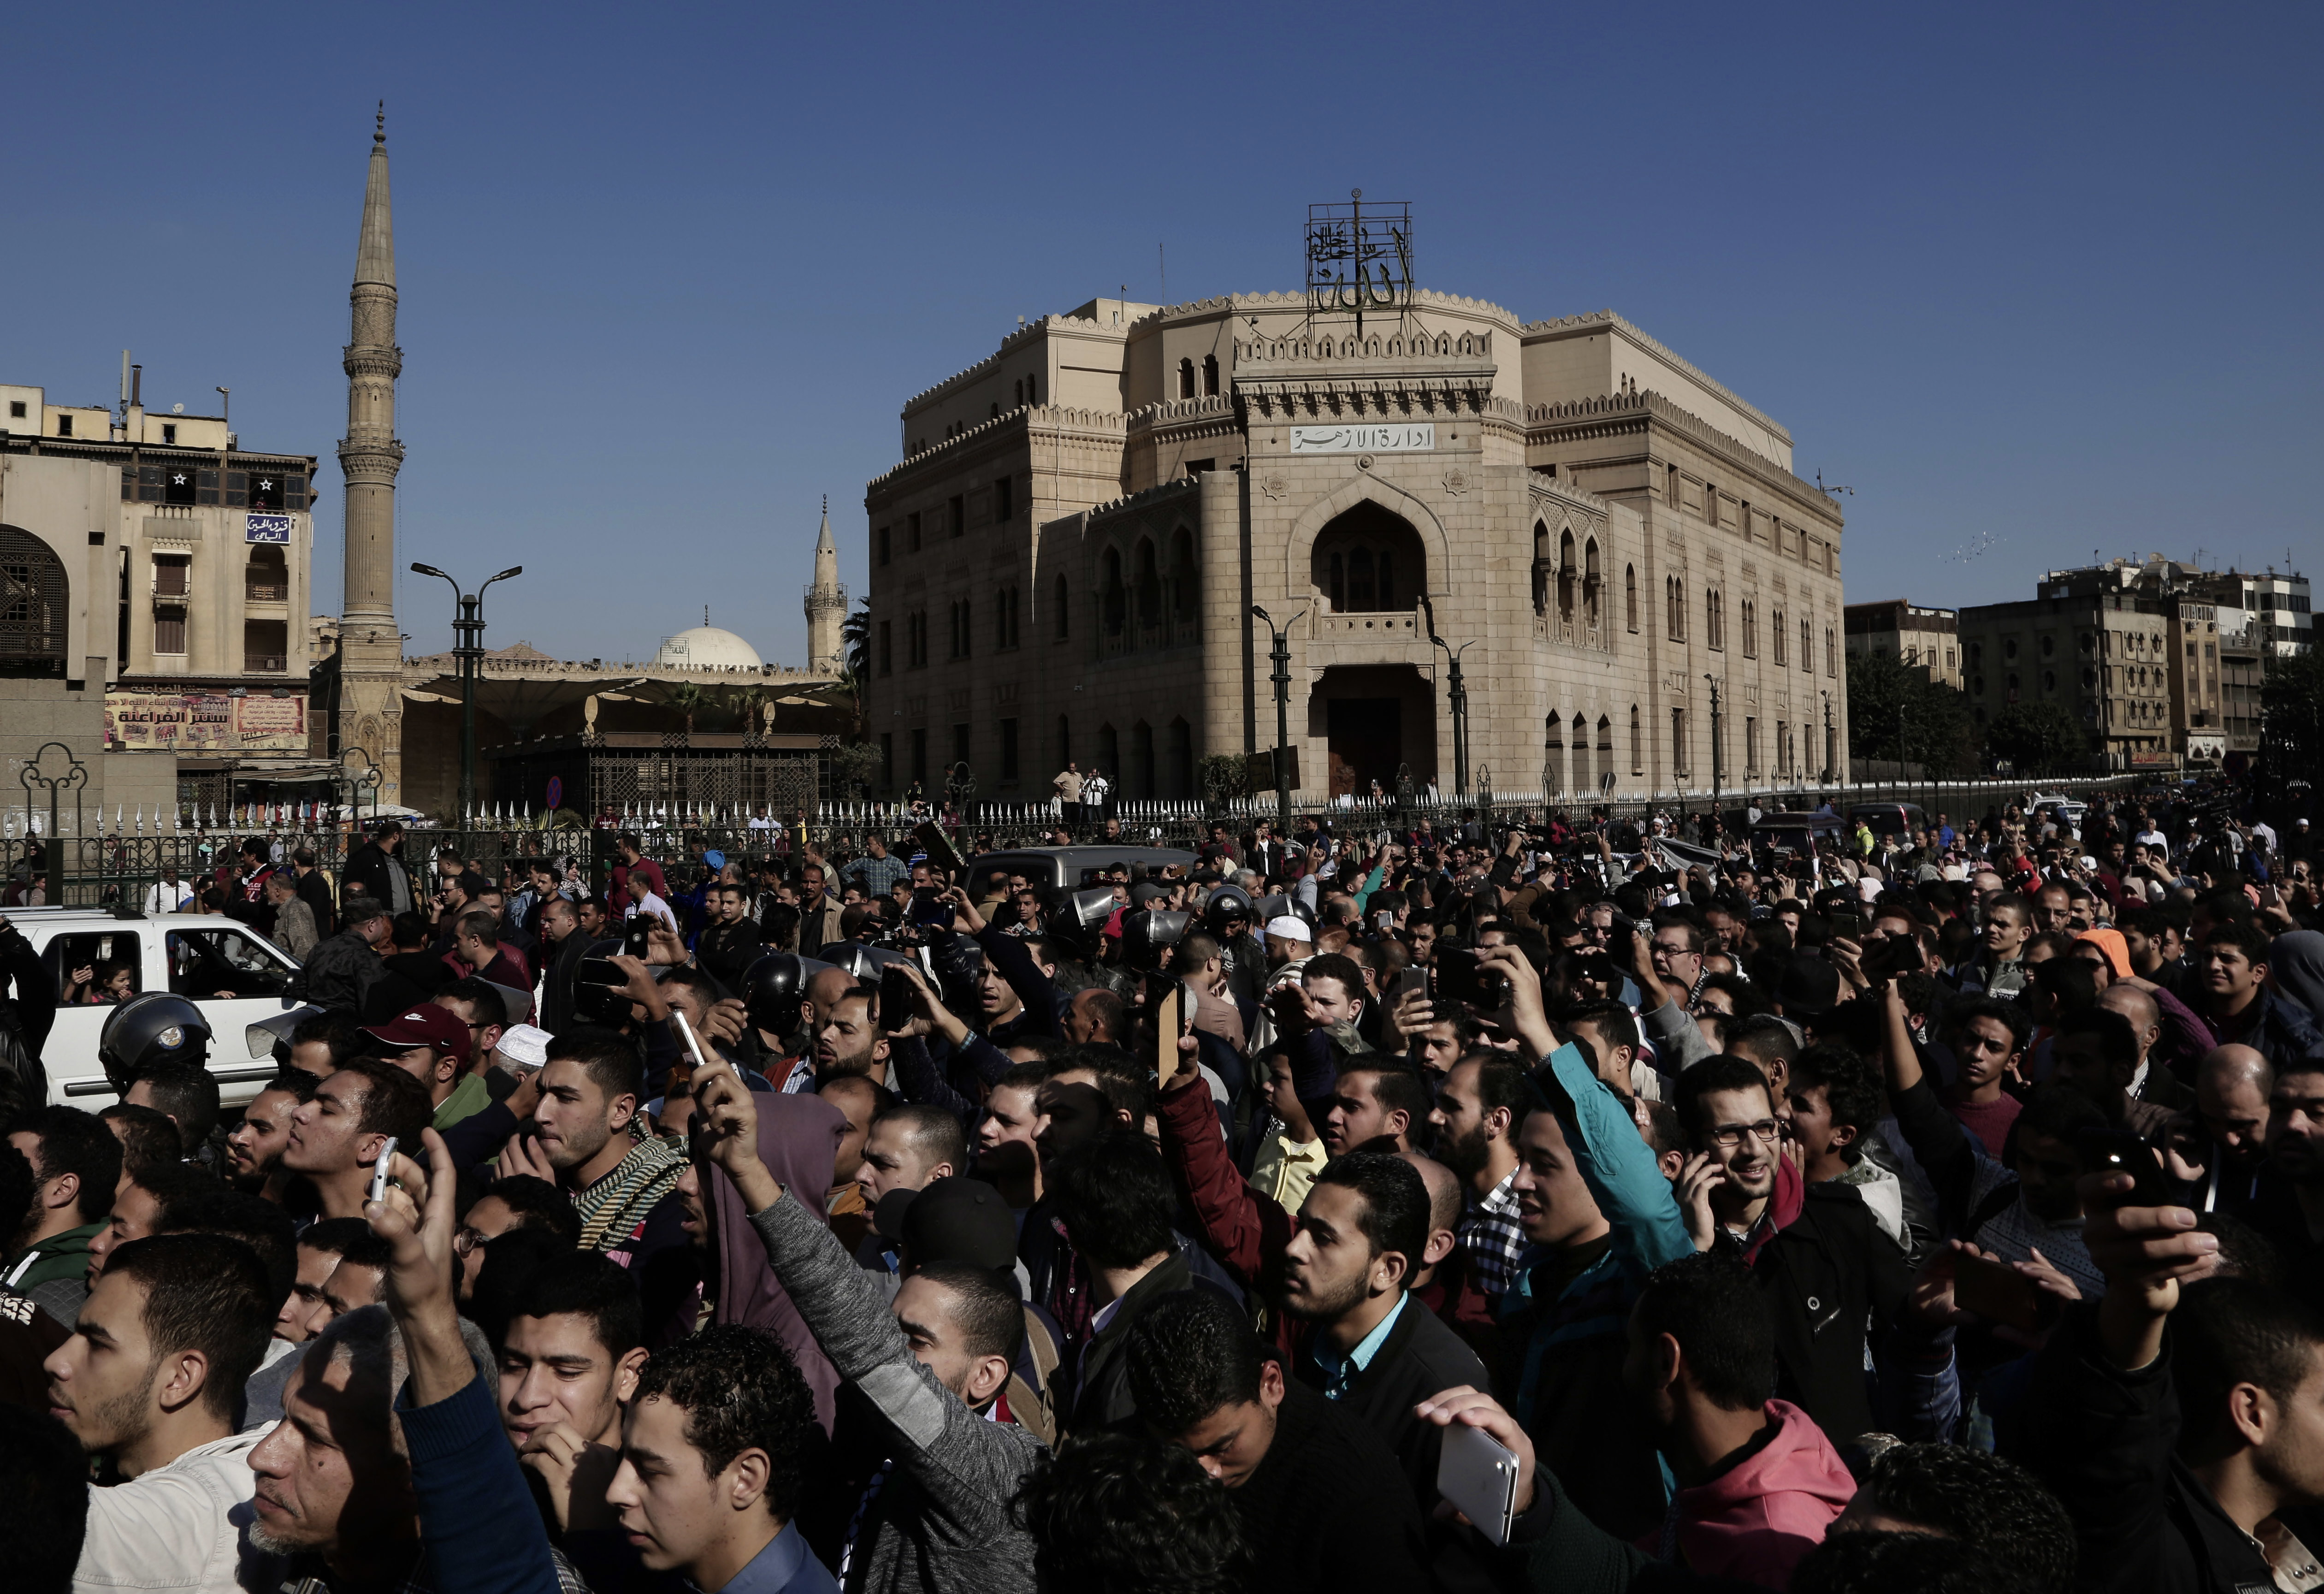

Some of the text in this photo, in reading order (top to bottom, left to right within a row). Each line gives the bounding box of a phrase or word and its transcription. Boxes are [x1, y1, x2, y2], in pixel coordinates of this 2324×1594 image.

[248, 519, 288, 532] فندق الحسين
[148, 698, 166, 706] شاء
[118, 711, 228, 725] سنتر الفراعنة
